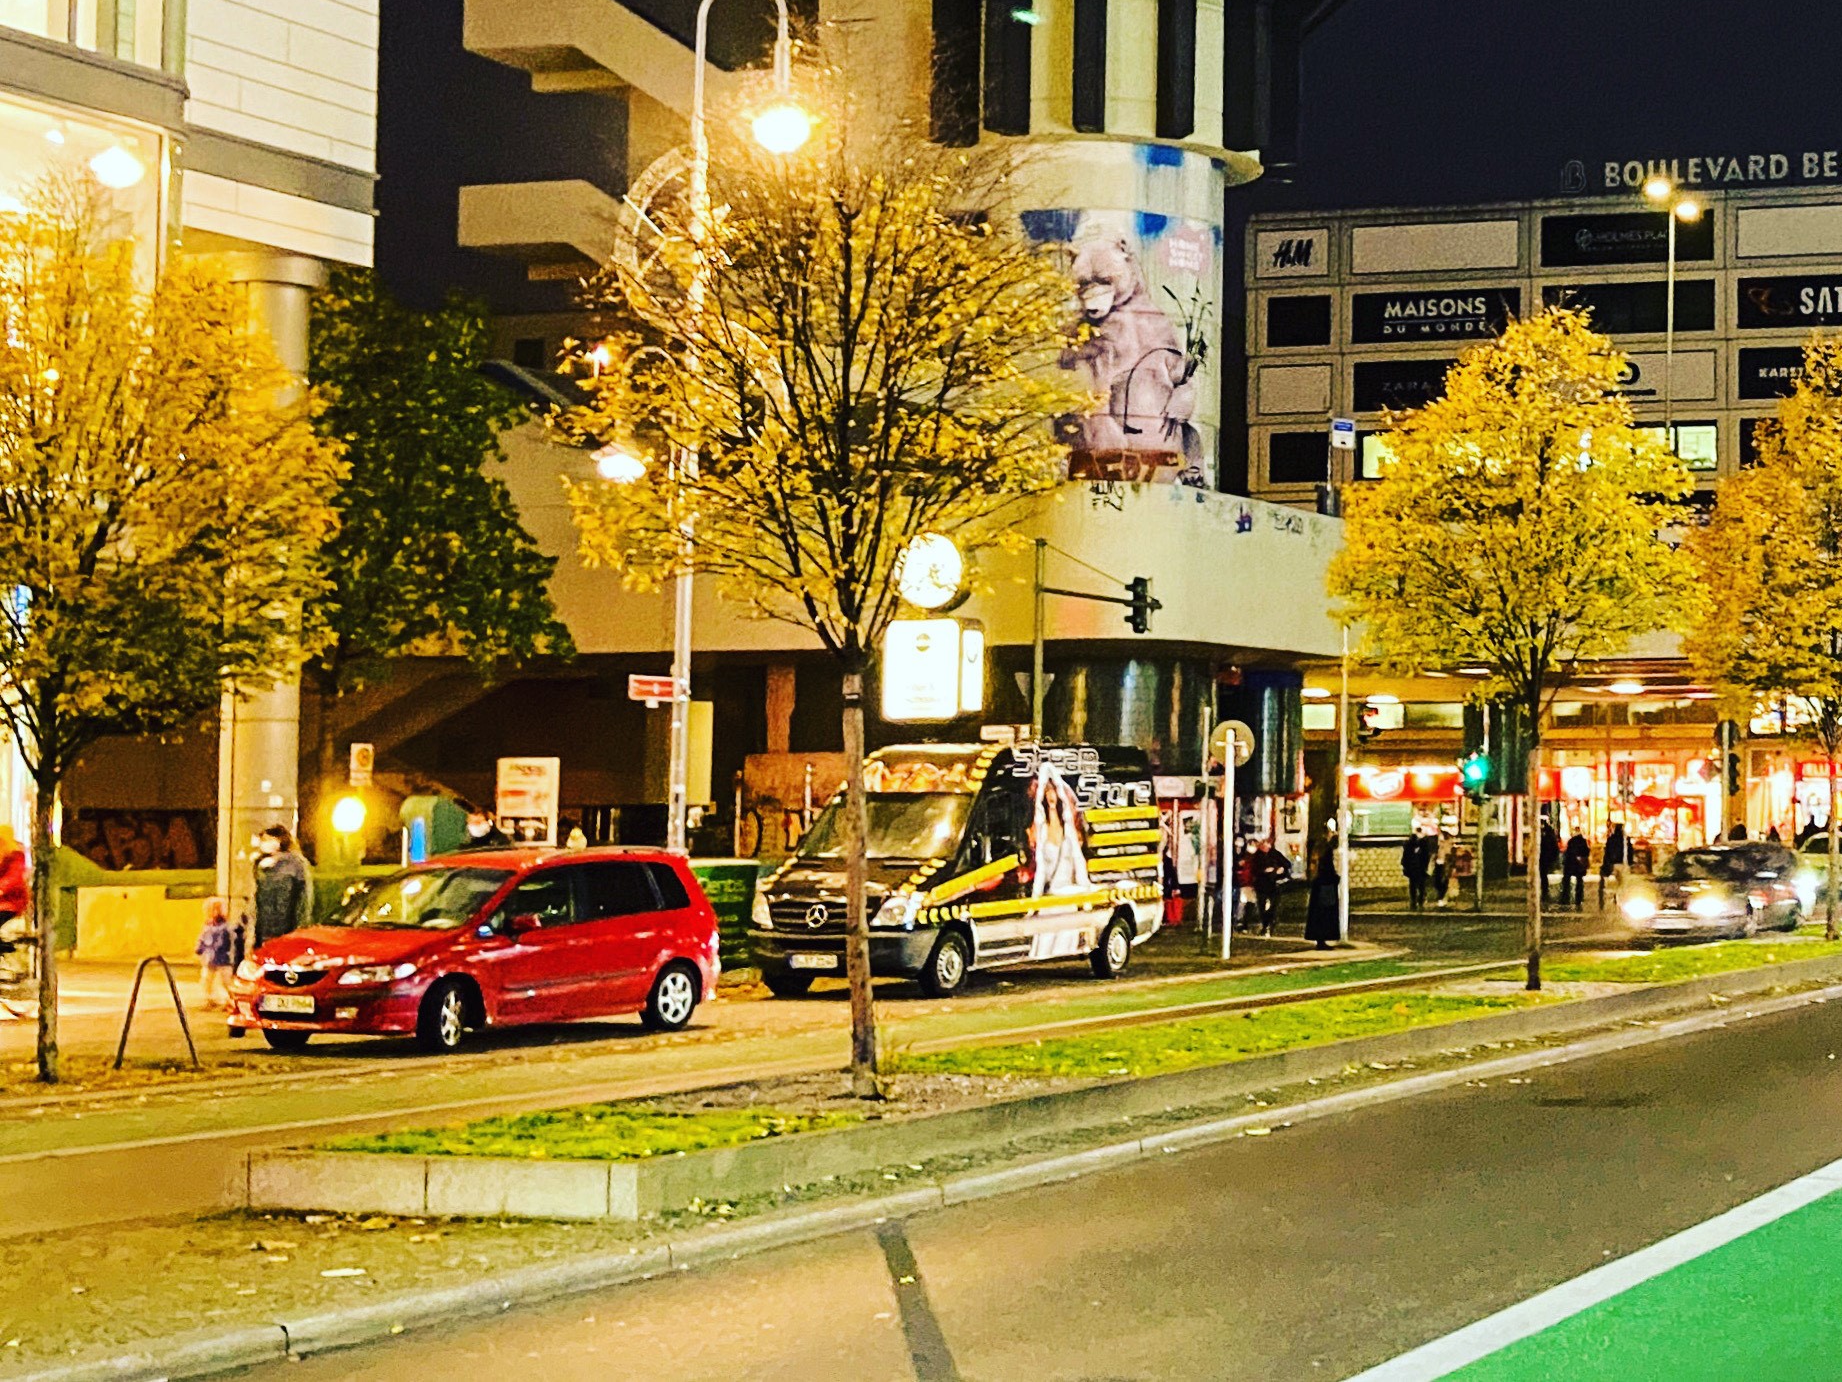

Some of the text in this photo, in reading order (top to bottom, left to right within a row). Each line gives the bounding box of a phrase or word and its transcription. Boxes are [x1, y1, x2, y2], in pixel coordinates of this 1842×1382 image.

[1604, 153, 1789, 188] BOULEVARD
[1383, 297, 1487, 319] MAISONS
[1382, 325, 1407, 335] DU
[1076, 773, 1152, 810] Store
